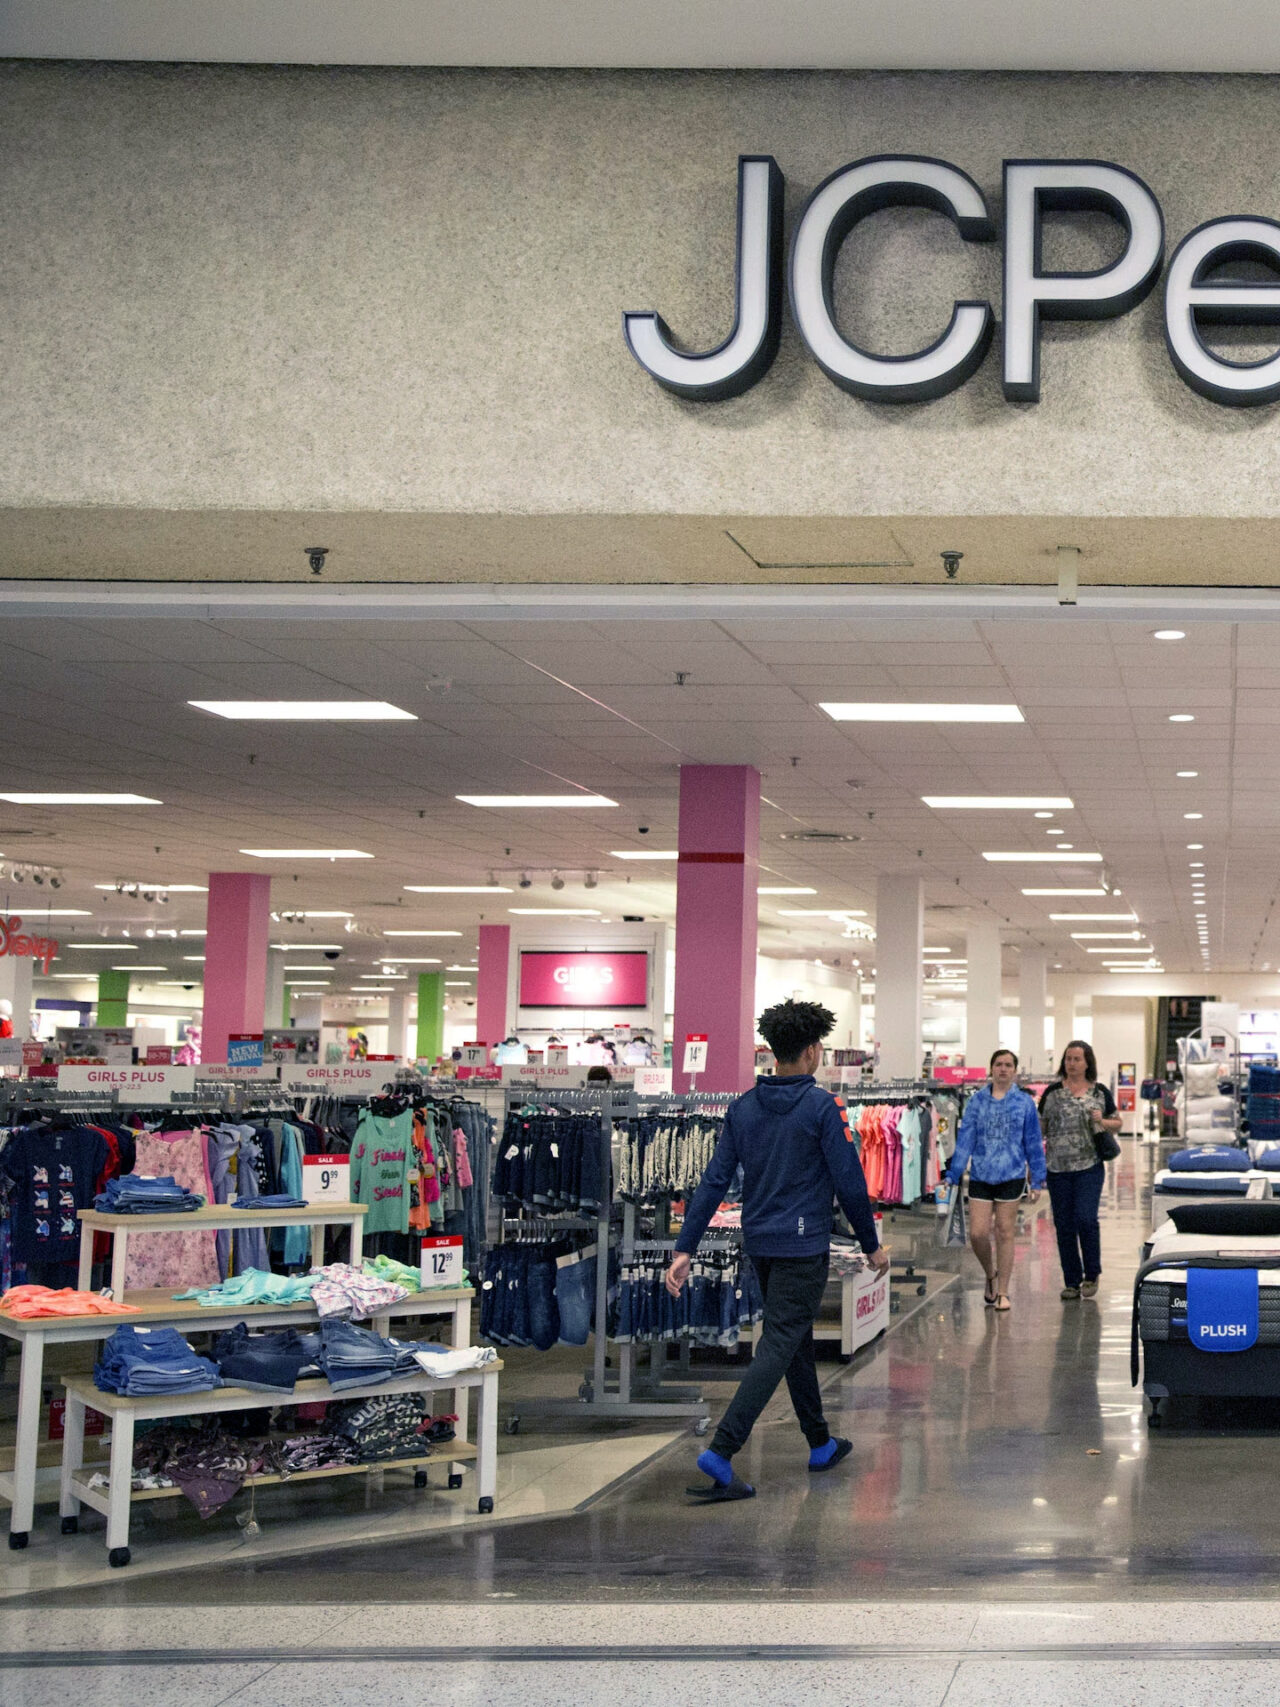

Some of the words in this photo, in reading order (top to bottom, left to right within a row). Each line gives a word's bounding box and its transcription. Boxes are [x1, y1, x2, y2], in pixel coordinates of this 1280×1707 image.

[553, 966, 613, 985] GIS
[231, 1044, 259, 1057] NEW
[208, 1066, 234, 1074] GIRLS
[236, 1066, 258, 1075] PUS
[306, 1069, 339, 1078] GIRLS
[343, 1069, 371, 1078] PLUS
[520, 1067, 545, 1075] GIRLS
[547, 1067, 569, 1075] PLUS
[87, 1072, 127, 1082] GIRLS
[131, 1072, 165, 1082] PLUS
[1200, 1324, 1247, 1337] PLUSH
